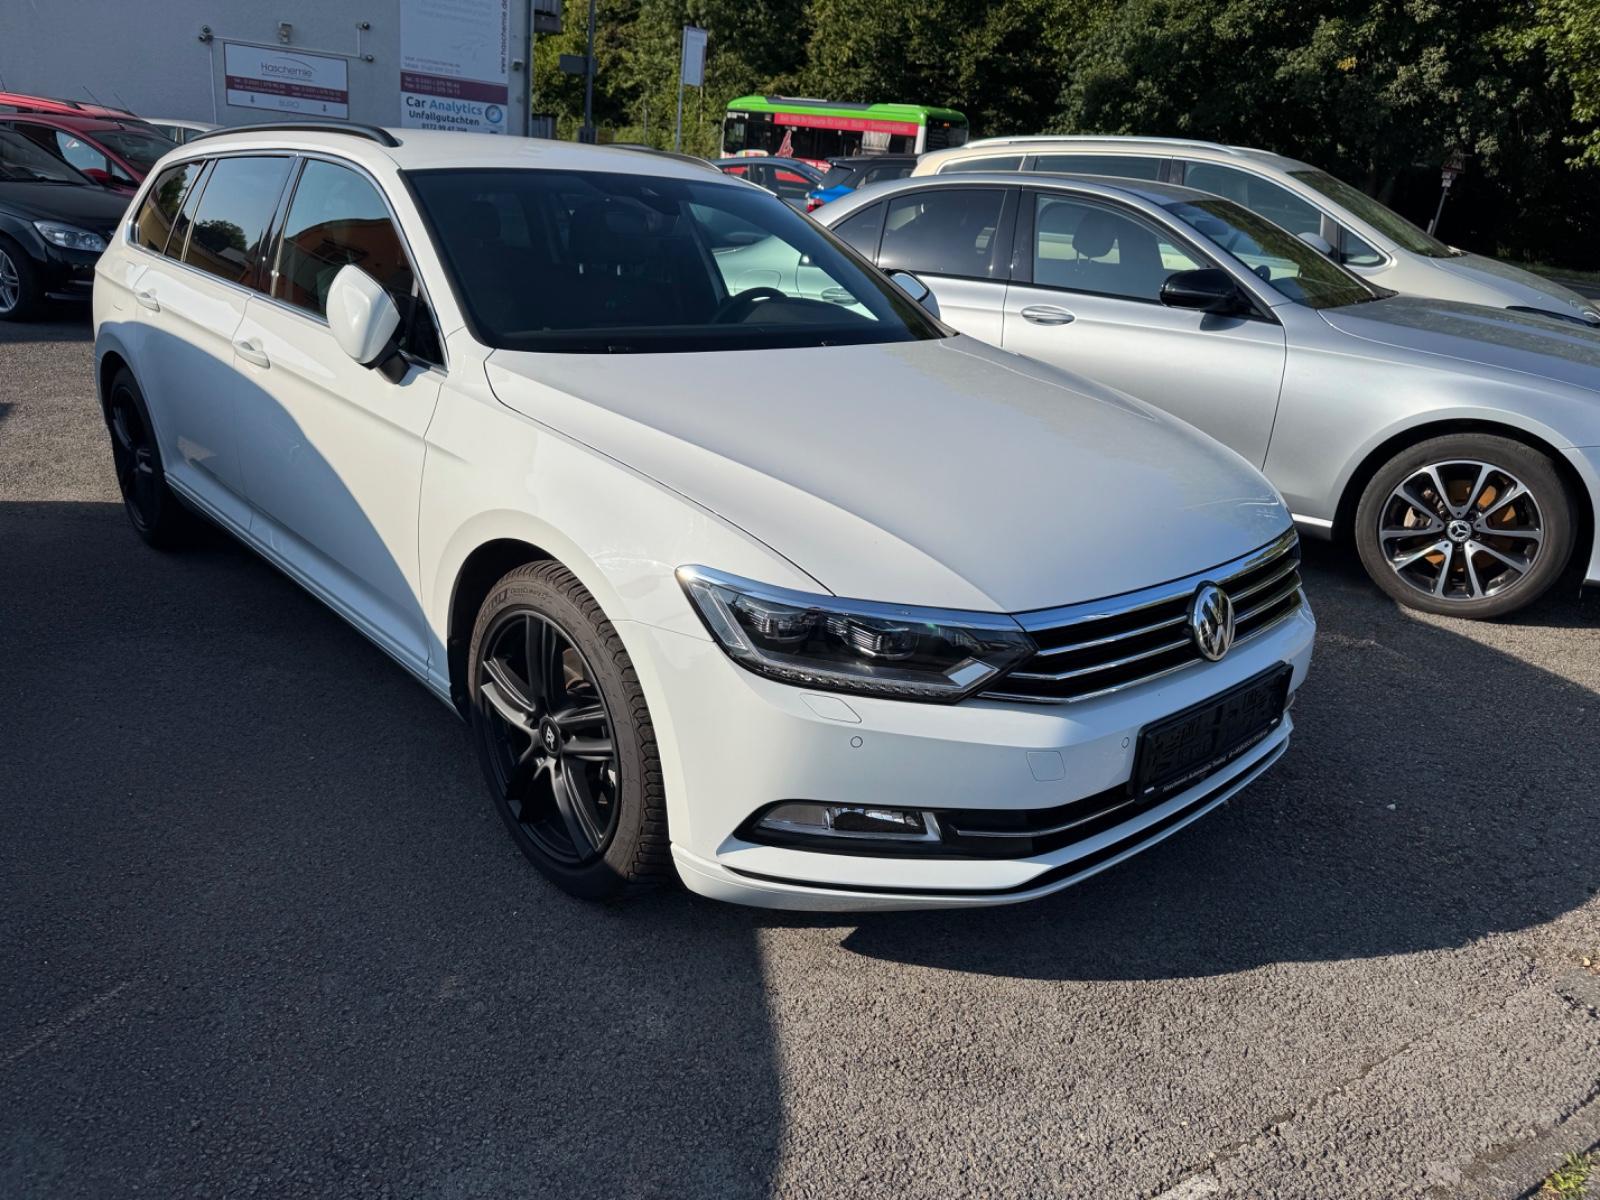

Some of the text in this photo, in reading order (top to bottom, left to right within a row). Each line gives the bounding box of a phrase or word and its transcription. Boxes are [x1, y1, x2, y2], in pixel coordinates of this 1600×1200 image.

[406, 96, 483, 116] Car Analytics
[408, 110, 480, 126] Unfallgutachten
